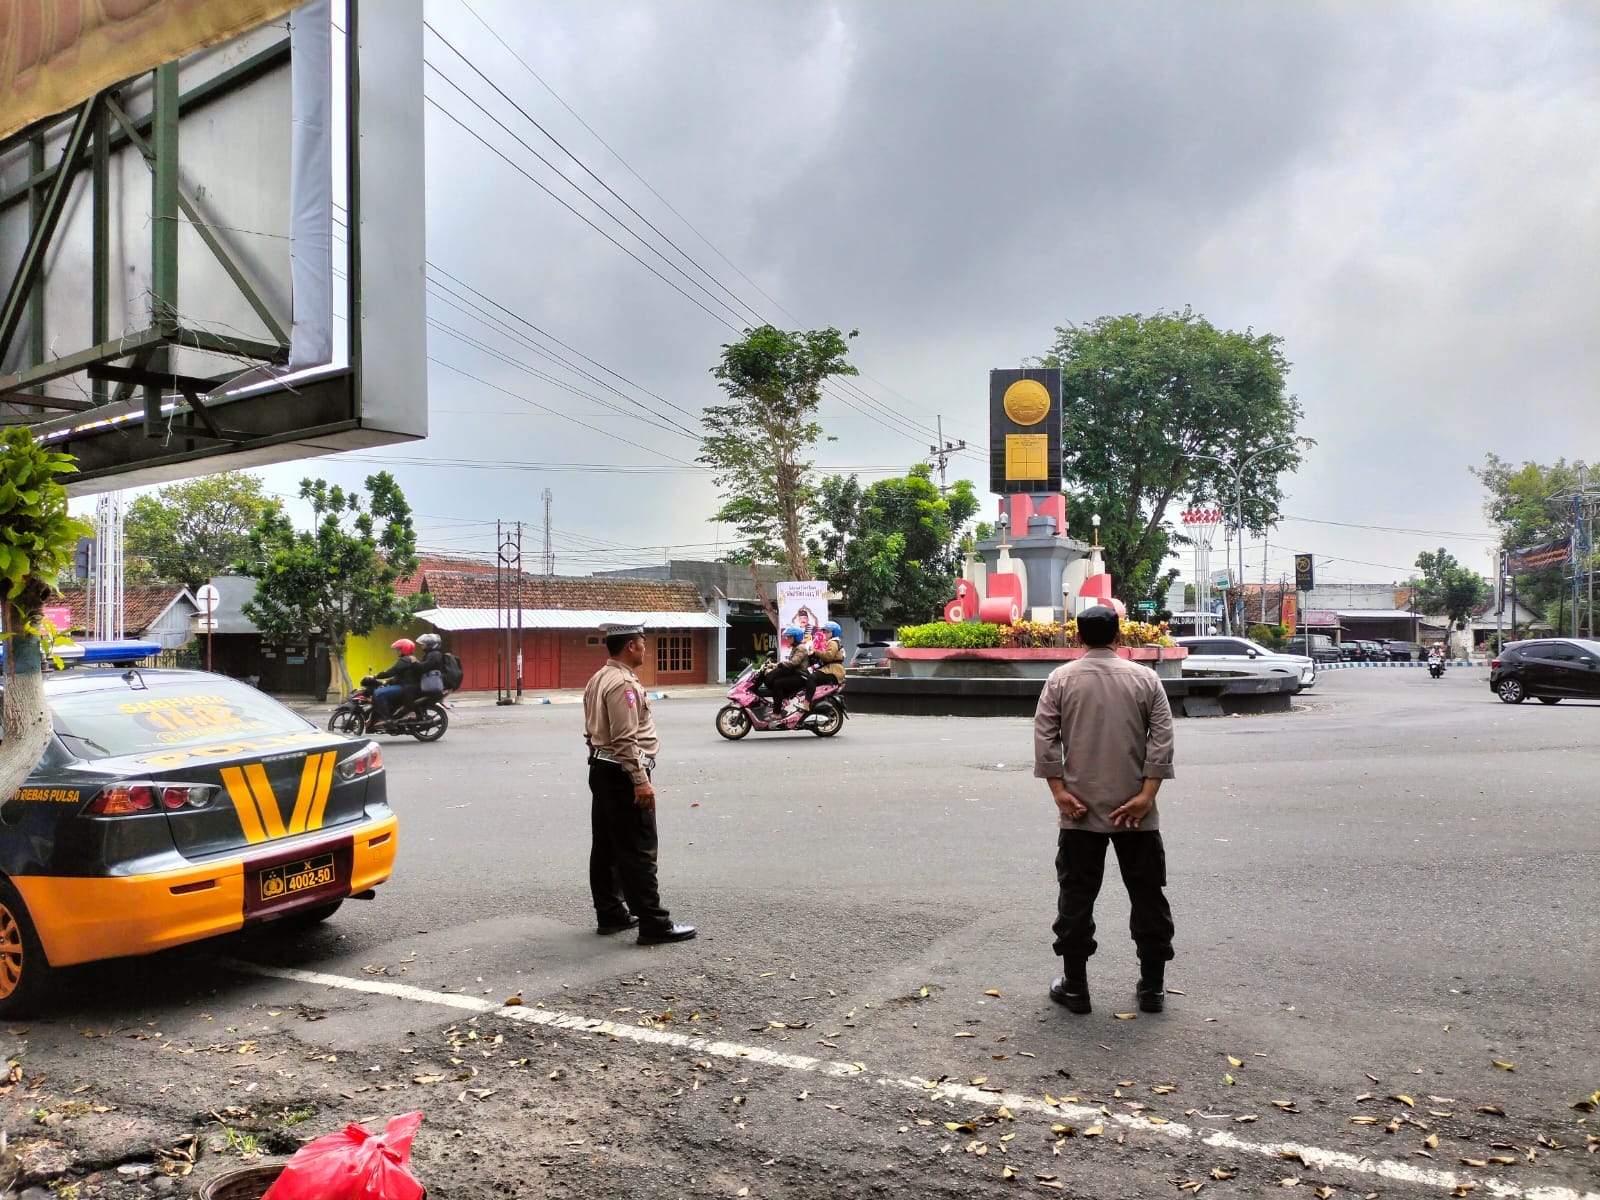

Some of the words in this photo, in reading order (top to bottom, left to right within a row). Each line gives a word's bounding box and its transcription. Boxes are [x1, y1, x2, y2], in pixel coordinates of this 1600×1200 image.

[49, 789, 80, 803] PULSA
[304, 861, 312, 870] X
[289, 867, 331, 890] 4002-50
